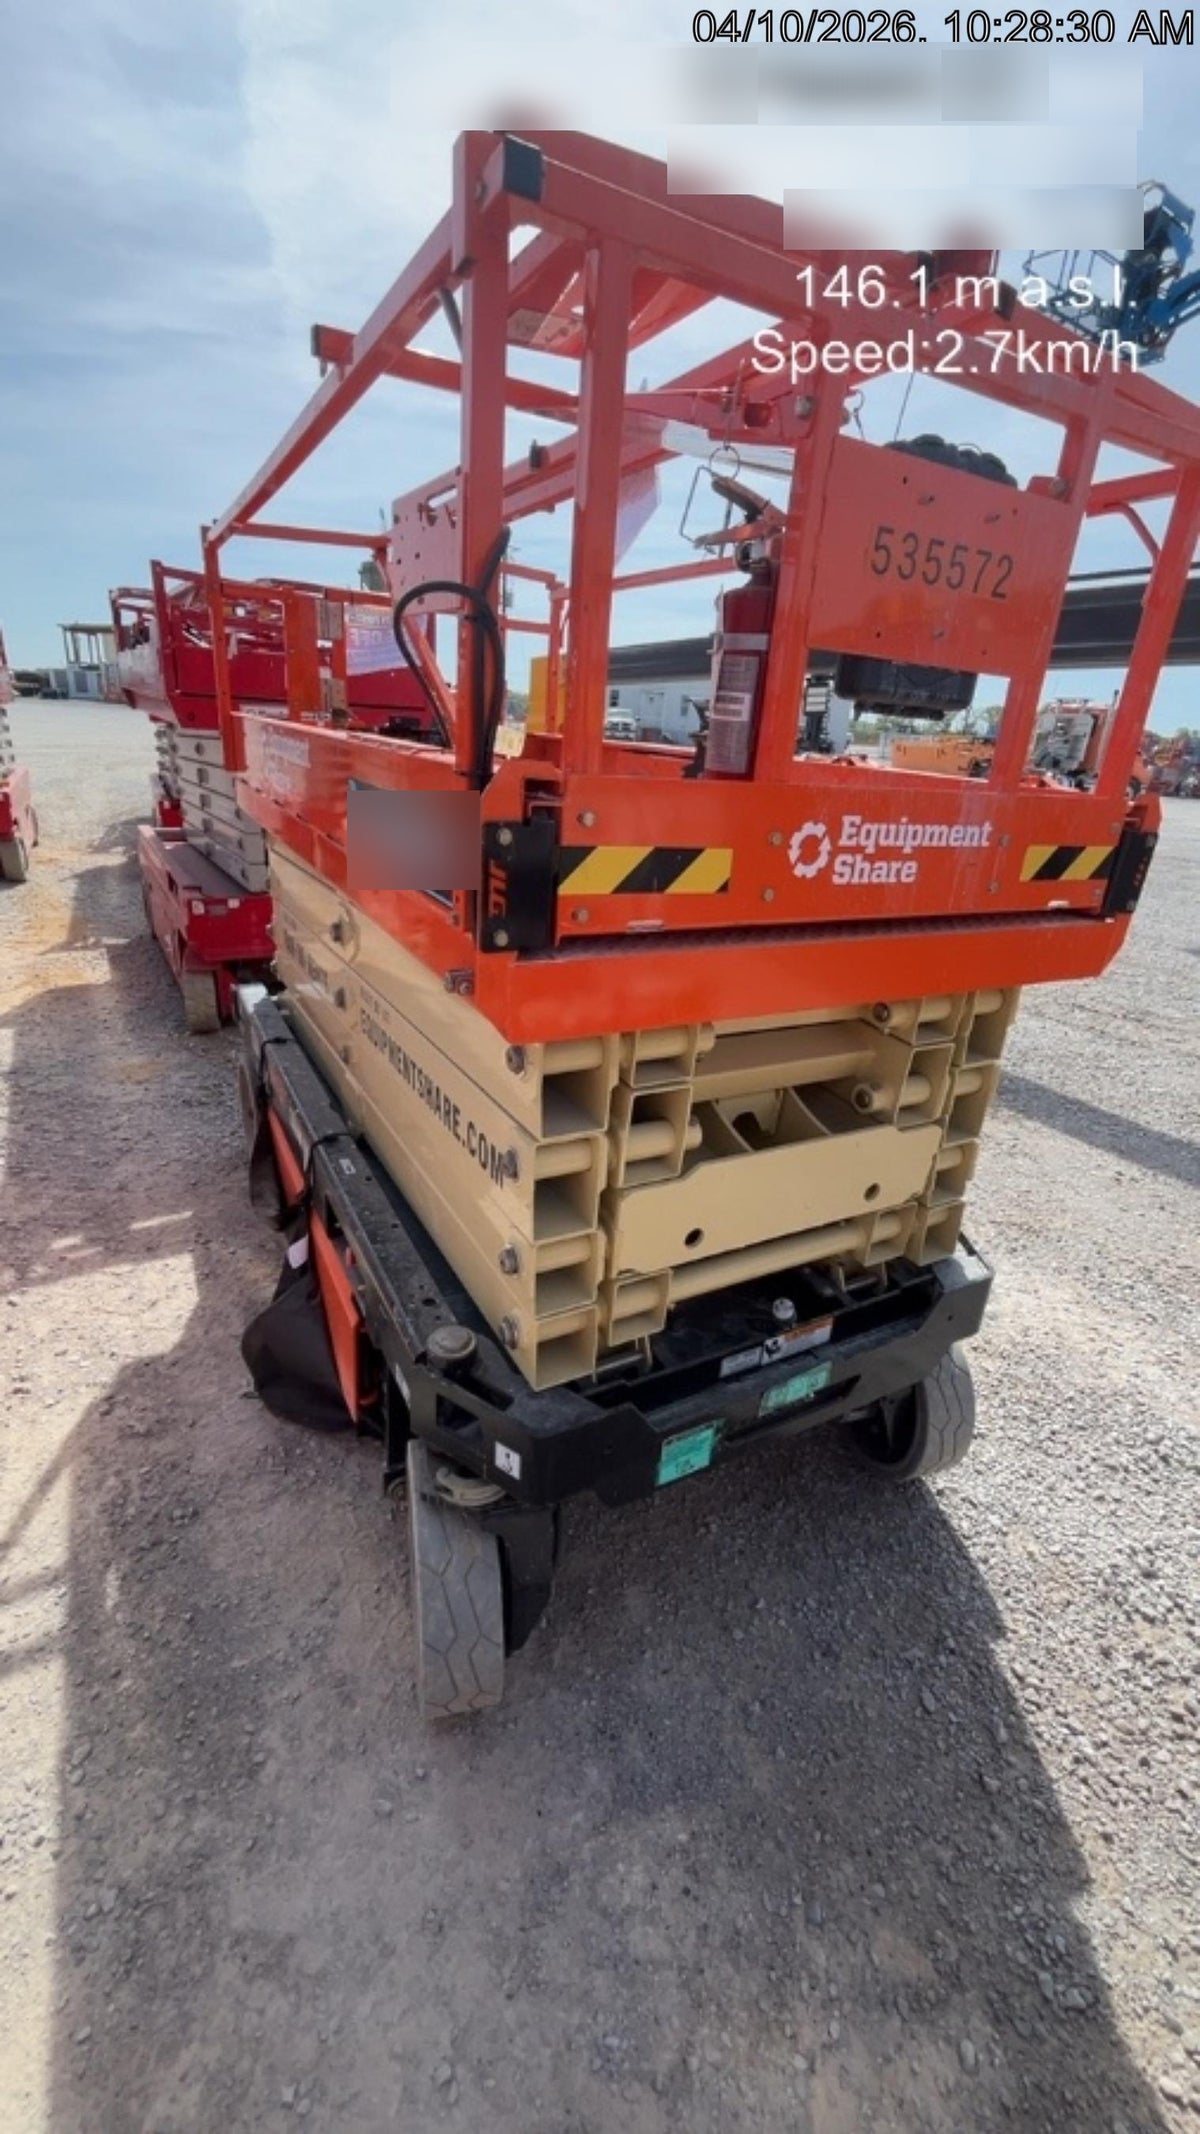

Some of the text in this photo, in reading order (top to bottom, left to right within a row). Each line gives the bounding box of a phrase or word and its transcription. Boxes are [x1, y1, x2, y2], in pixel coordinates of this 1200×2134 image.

[870, 525, 1014, 599] 535572
[838, 814, 993, 854] Equipment
[832, 853, 919, 886] Share
